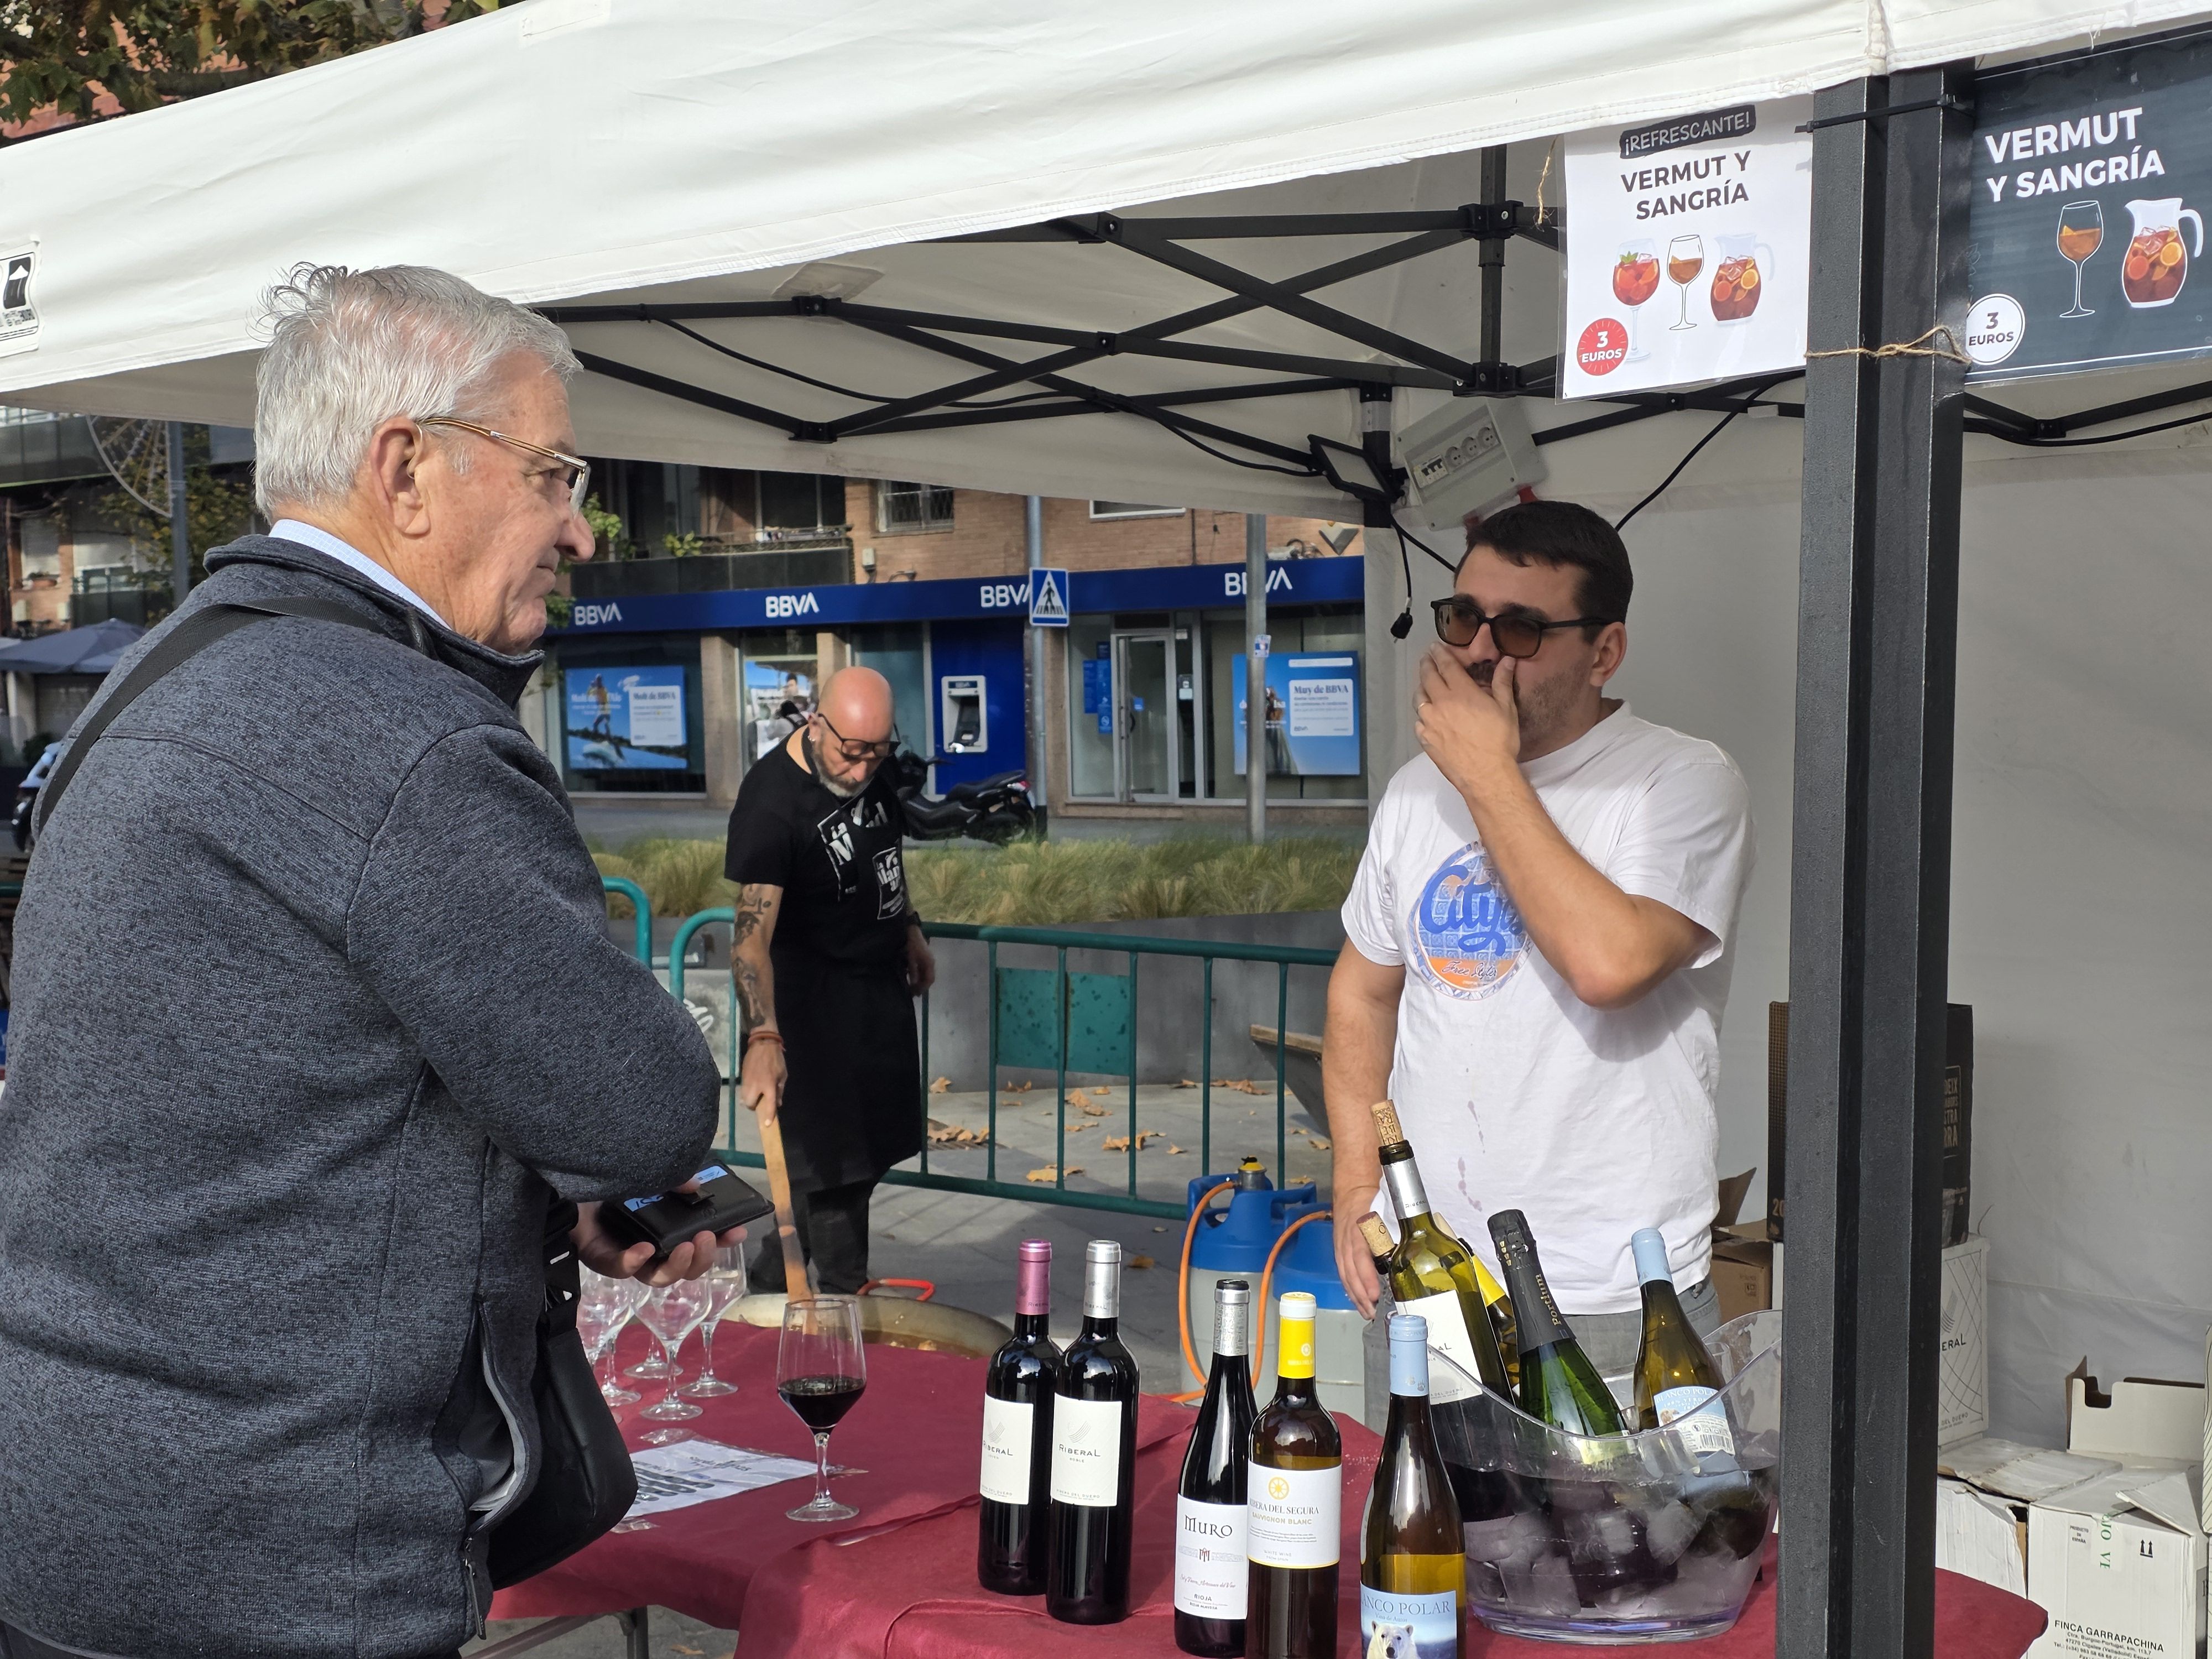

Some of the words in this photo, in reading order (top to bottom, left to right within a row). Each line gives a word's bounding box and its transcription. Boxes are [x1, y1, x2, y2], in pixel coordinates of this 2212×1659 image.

[1625, 112, 1750, 155] ¡REFRESCANTE!
[1985, 107, 2142, 164] VERMUT
[1621, 155, 1726, 192] VERMUT
[1734, 150, 1751, 171] Y
[1986, 175, 2007, 202] Y
[2016, 145, 2165, 198] SANGRÍA
[1636, 179, 1749, 220] SANGRÍA
[1986, 312, 1999, 329] 3
[1597, 331, 1608, 348] 3
[1969, 331, 2014, 346] EUROS
[1582, 348, 1622, 363] EUROS
[1224, 567, 1293, 596] BVA
[575, 602, 623, 625] BBVA
[766, 592, 819, 618] BBVA
[1293, 686, 1312, 695] Muy
[1314, 685, 1324, 693] de
[1442, 961, 1469, 975] Free
[1536, 1274, 1562, 1326] Portium
[1942, 1333, 1966, 1351] ERAL
[1692, 1388, 1716, 1396] POLA
[1058, 1444, 1101, 1457] RIBERAL
[1269, 1504, 1285, 1514] DEL
[1286, 1506, 1319, 1515] SEGURA
[1194, 1593, 1212, 1601] RIOJA
[1361, 1593, 1394, 1614] ANCO
[1399, 1600, 1451, 1615] POLAR
[2054, 1620, 2084, 1634] FINCA
[2086, 1627, 2164, 1653] GARRAPACHINA
